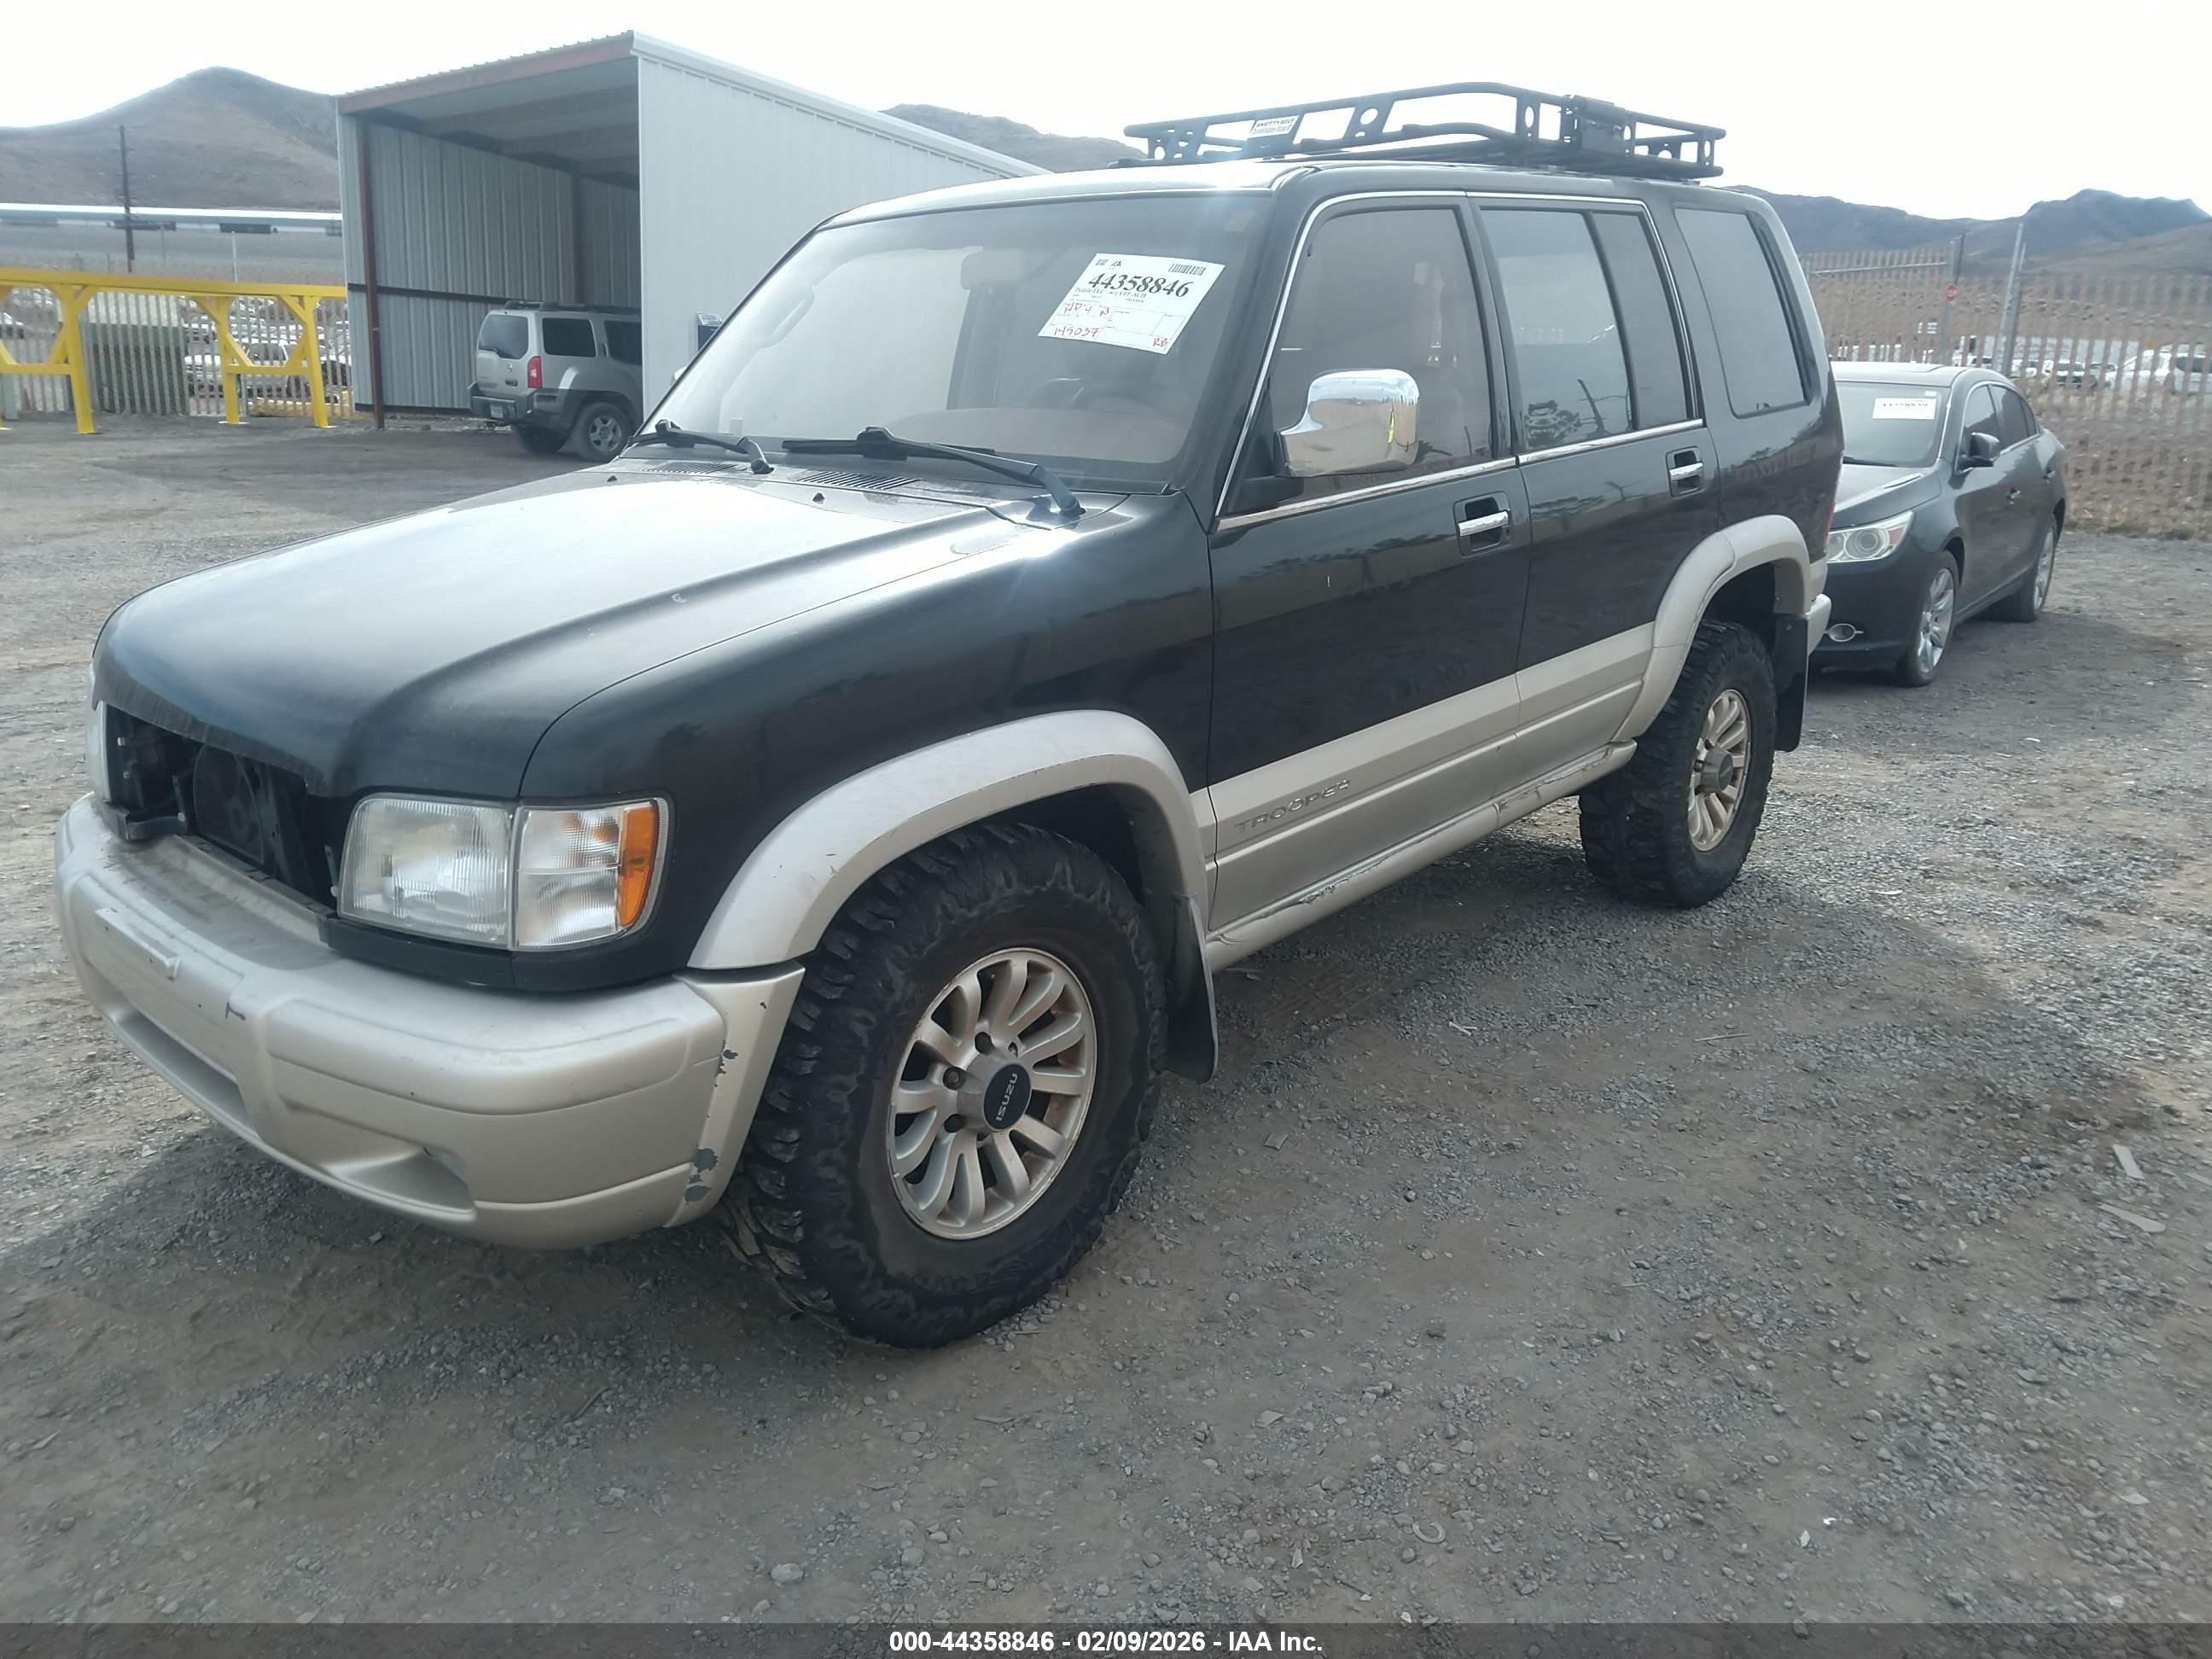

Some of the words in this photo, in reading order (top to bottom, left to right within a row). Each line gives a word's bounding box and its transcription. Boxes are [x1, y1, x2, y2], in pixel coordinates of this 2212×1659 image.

[1088, 272, 1195, 298] 44358846
[1234, 778, 1352, 832] TROOPER
[995, 1073, 1018, 1121] ISUZU
